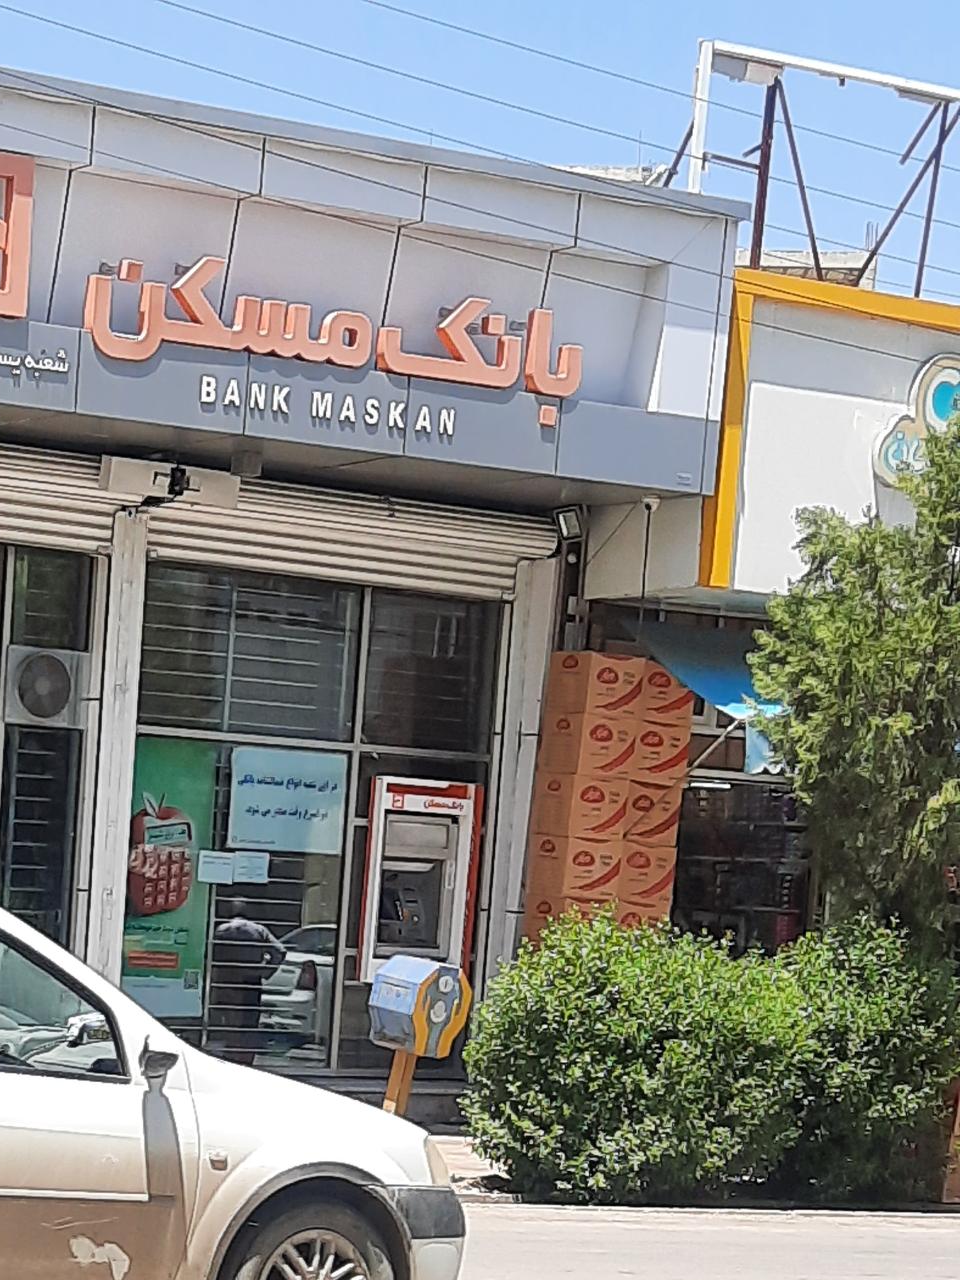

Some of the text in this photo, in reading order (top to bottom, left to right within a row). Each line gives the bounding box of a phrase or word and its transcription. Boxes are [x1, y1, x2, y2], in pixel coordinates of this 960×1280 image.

[24, 348, 70, 377] شعبه
[82, 256, 584, 427] بانک مسکن
[201, 374, 456, 436] BANK MASKAN
